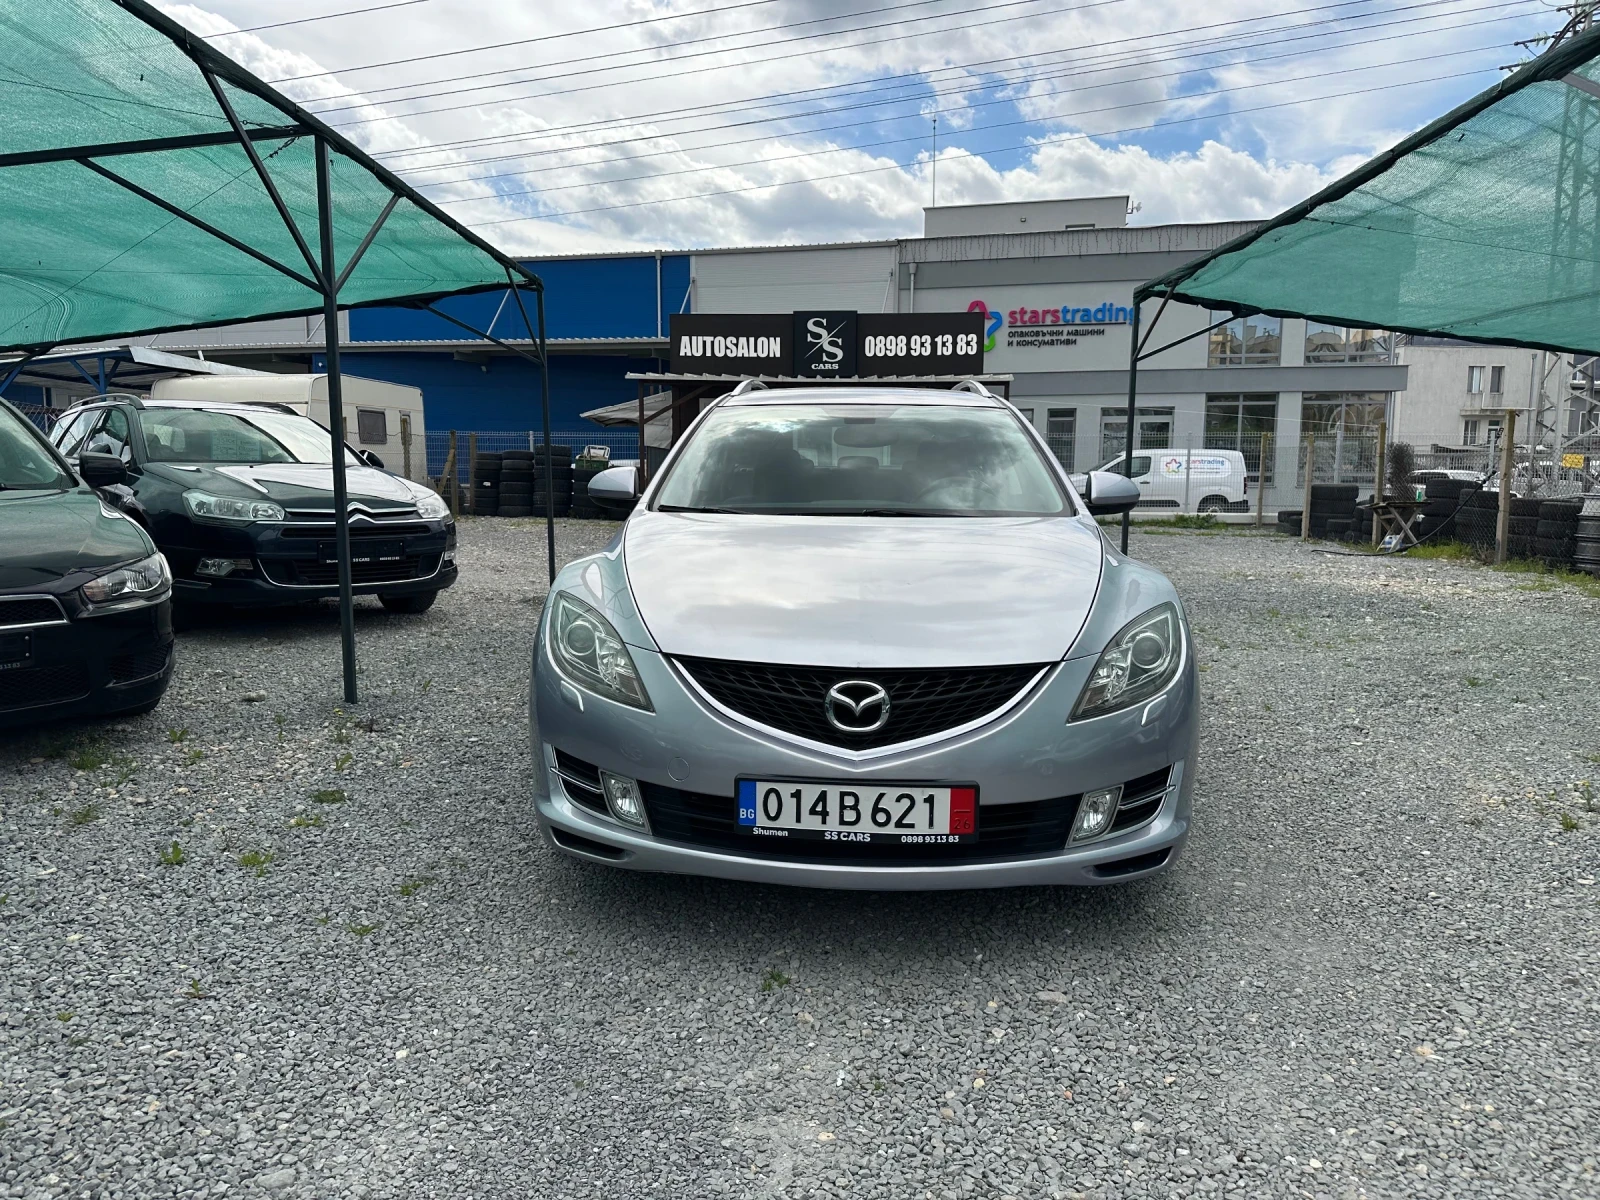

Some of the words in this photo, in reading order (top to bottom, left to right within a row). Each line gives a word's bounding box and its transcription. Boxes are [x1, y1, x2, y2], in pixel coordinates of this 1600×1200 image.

[1008, 329, 1064, 338] опаковъчни
[1067, 327, 1105, 337] машини
[679, 335, 781, 357] AUTOSALON
[864, 335, 907, 357] 0898
[910, 334, 933, 357] 93
[934, 334, 954, 356] 13
[956, 333, 978, 356] 83
[1007, 339, 1014, 347] и
[1016, 337, 1077, 348] консумативи
[811, 362, 839, 370] CARS
[739, 808, 755, 819] BG
[953, 817, 971, 830] 26
[752, 827, 789, 837] Shumen
[824, 831, 839, 840] SS
[840, 832, 871, 842] CARS
[901, 835, 923, 843] 0898
[924, 835, 936, 843] 93
[936, 835, 947, 843] 13
[948, 835, 959, 843] 83
